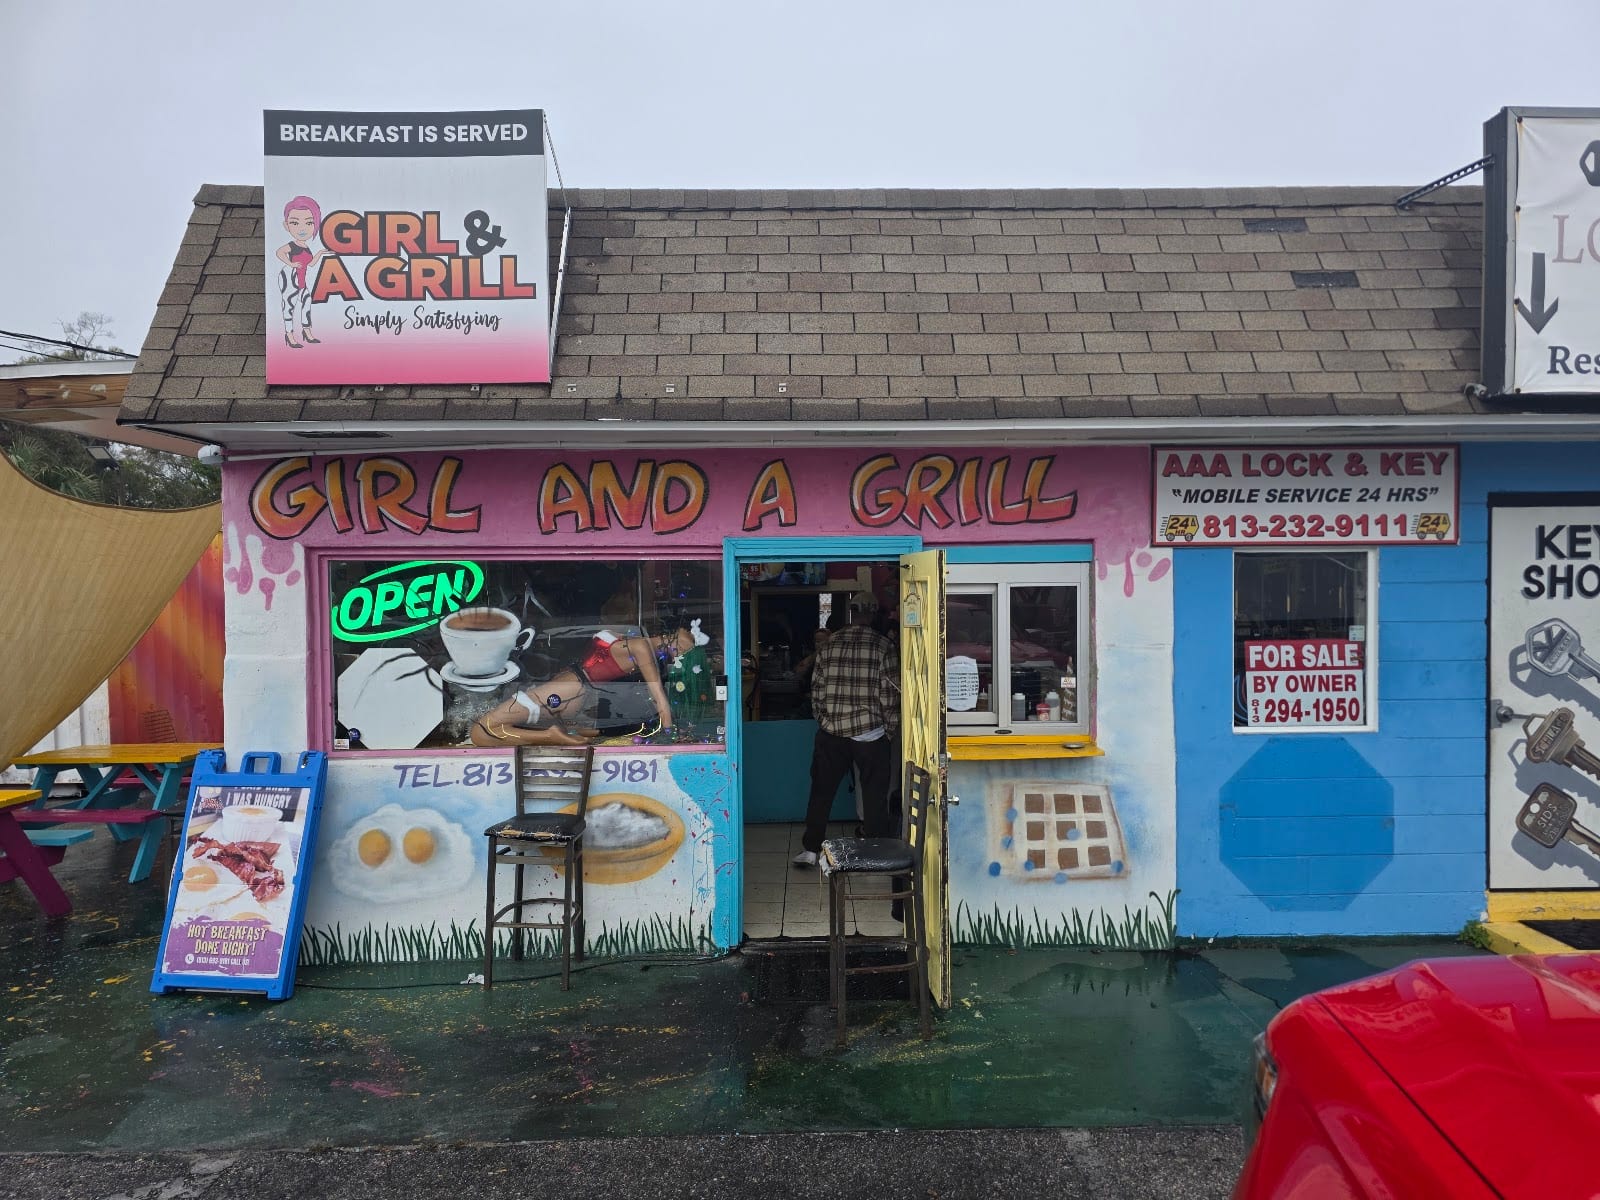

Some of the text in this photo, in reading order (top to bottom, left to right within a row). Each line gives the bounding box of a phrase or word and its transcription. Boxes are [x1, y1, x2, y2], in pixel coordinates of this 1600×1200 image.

[280, 123, 528, 143] BREAKFAST IS SERVED
[319, 209, 507, 256] GIRL &
[1552, 214, 1600, 263] L
[311, 254, 537, 304] A GRILL
[343, 305, 502, 335] Simply Satisfying
[1162, 451, 1449, 477] AAA LOCK & KEY
[248, 453, 1077, 540] GIRL AND A GRILL
[1264, 488, 1352, 503] SERVICE
[1356, 487, 1380, 503] 24
[1168, 517, 1190, 530] 24
[1202, 513, 1408, 538] 813-232-9111
[1420, 515, 1441, 528] 24
[1535, 524, 1600, 561] KE
[339, 569, 465, 631] OPEN
[1249, 643, 1360, 669] FOR SALE
[1253, 674, 1357, 693] BY OWNER
[1264, 697, 1361, 723] 294-1950
[253, 793, 292, 809] HUNGRY
[187, 924, 268, 942] HOT BREAKFAST
[194, 939, 257, 956] DONE RIGHT!
